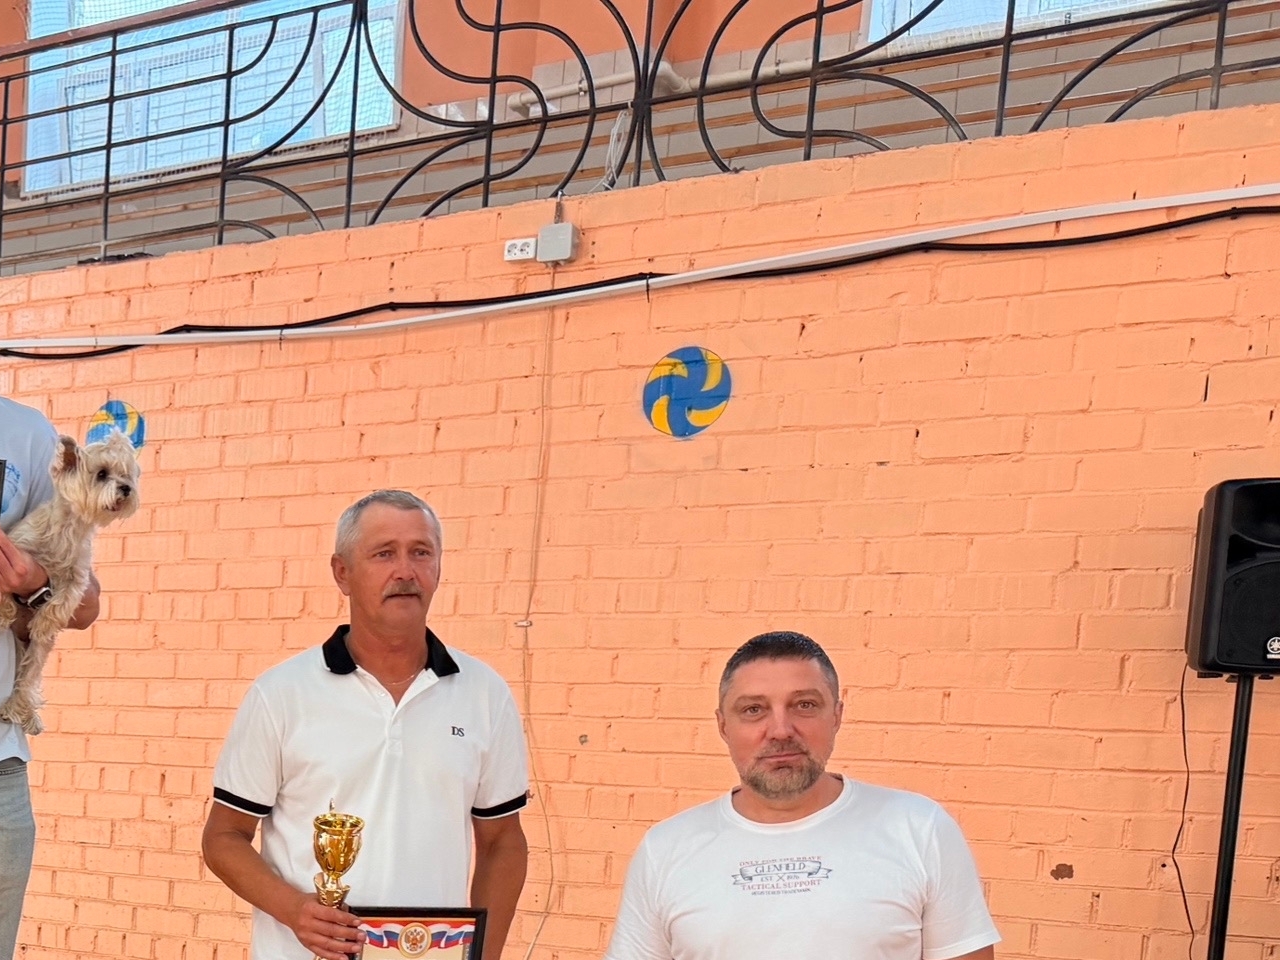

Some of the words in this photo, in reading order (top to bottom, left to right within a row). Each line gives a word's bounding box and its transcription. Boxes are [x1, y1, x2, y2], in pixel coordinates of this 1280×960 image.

[451, 725, 465, 737] DS
[754, 862, 807, 874] GLENFIELD
[741, 882, 782, 892] TACTICAL
[782, 879, 822, 889] SUPPORT
